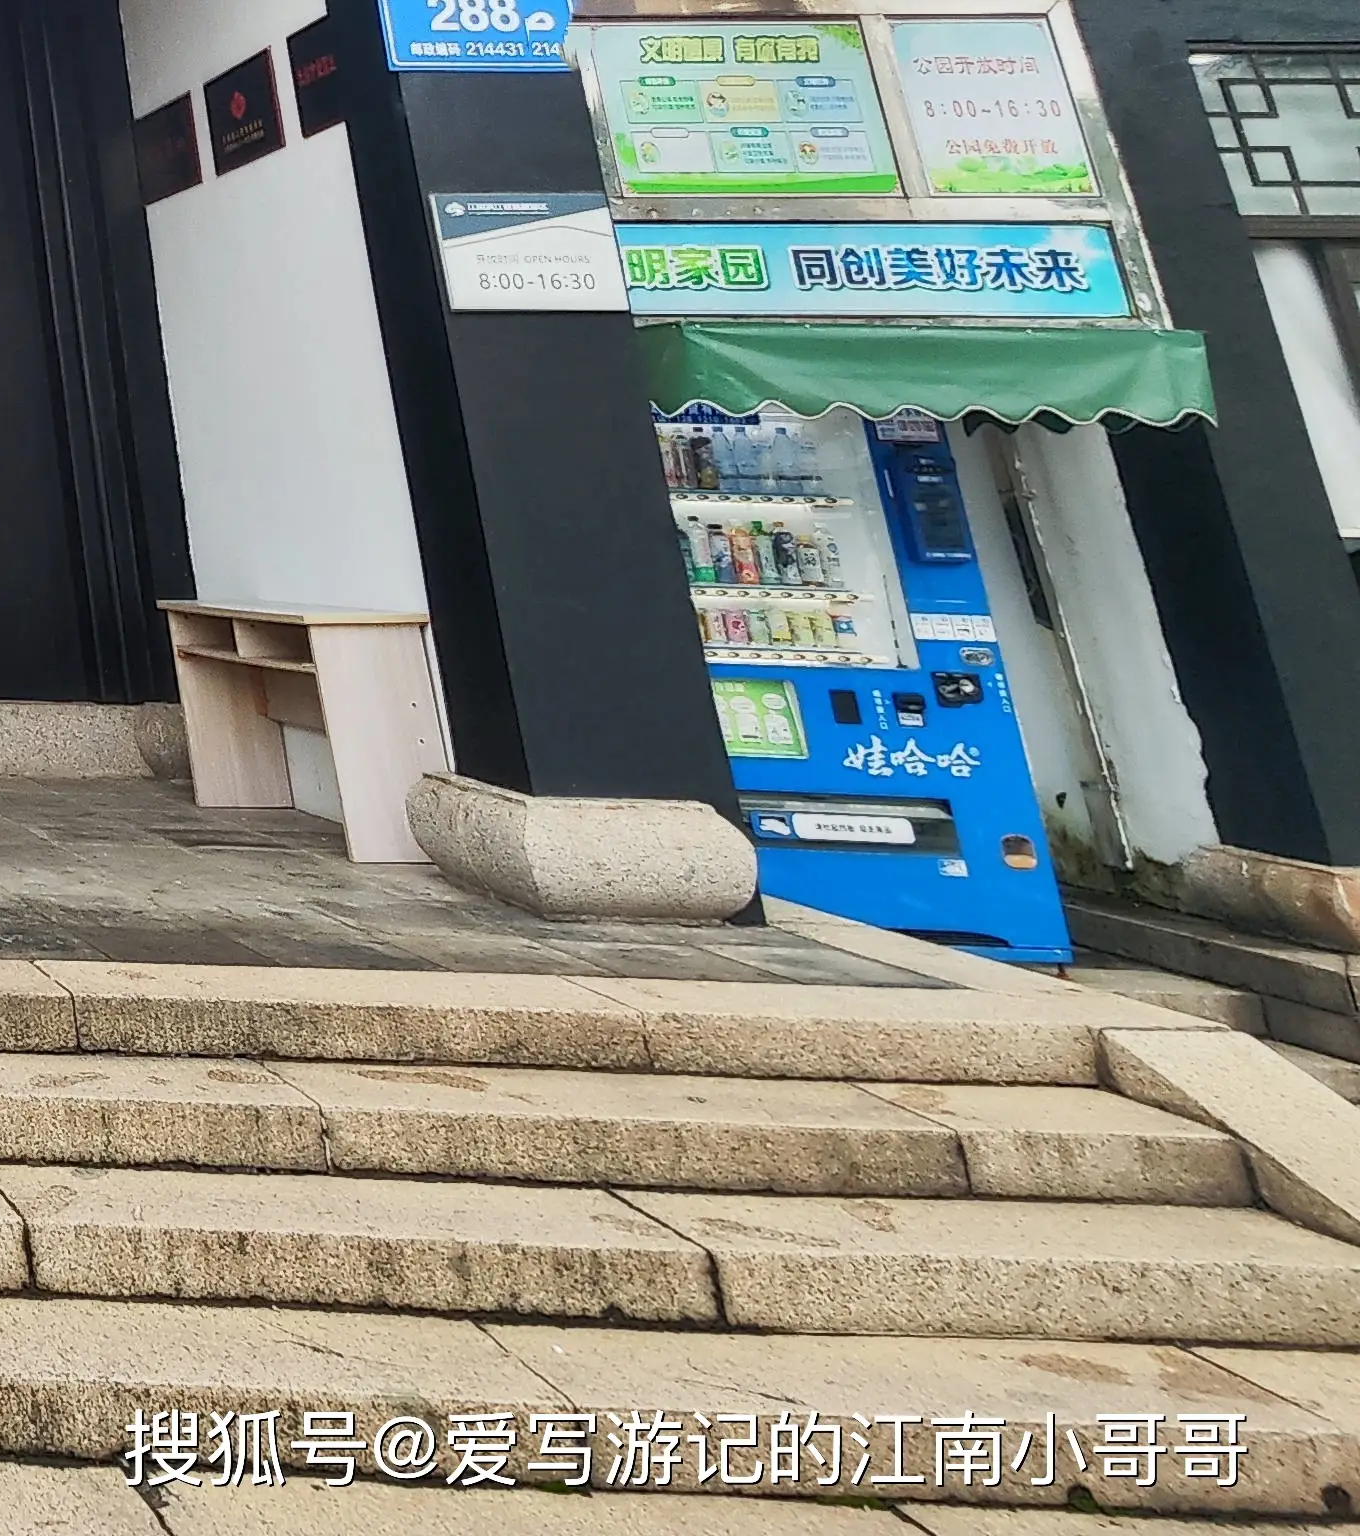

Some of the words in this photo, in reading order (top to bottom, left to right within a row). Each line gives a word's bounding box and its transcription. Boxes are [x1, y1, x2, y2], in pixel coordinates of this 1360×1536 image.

[465, 41, 525, 57] 214431
[912, 56, 1040, 76] 公园开放时间
[523, 255, 552, 264] OPEN
[554, 255, 591, 264] HOURS
[789, 244, 1089, 293] 同创美好未来
[478, 272, 596, 291] 8:00-16:30
[843, 734, 981, 778] 娃哈哈
